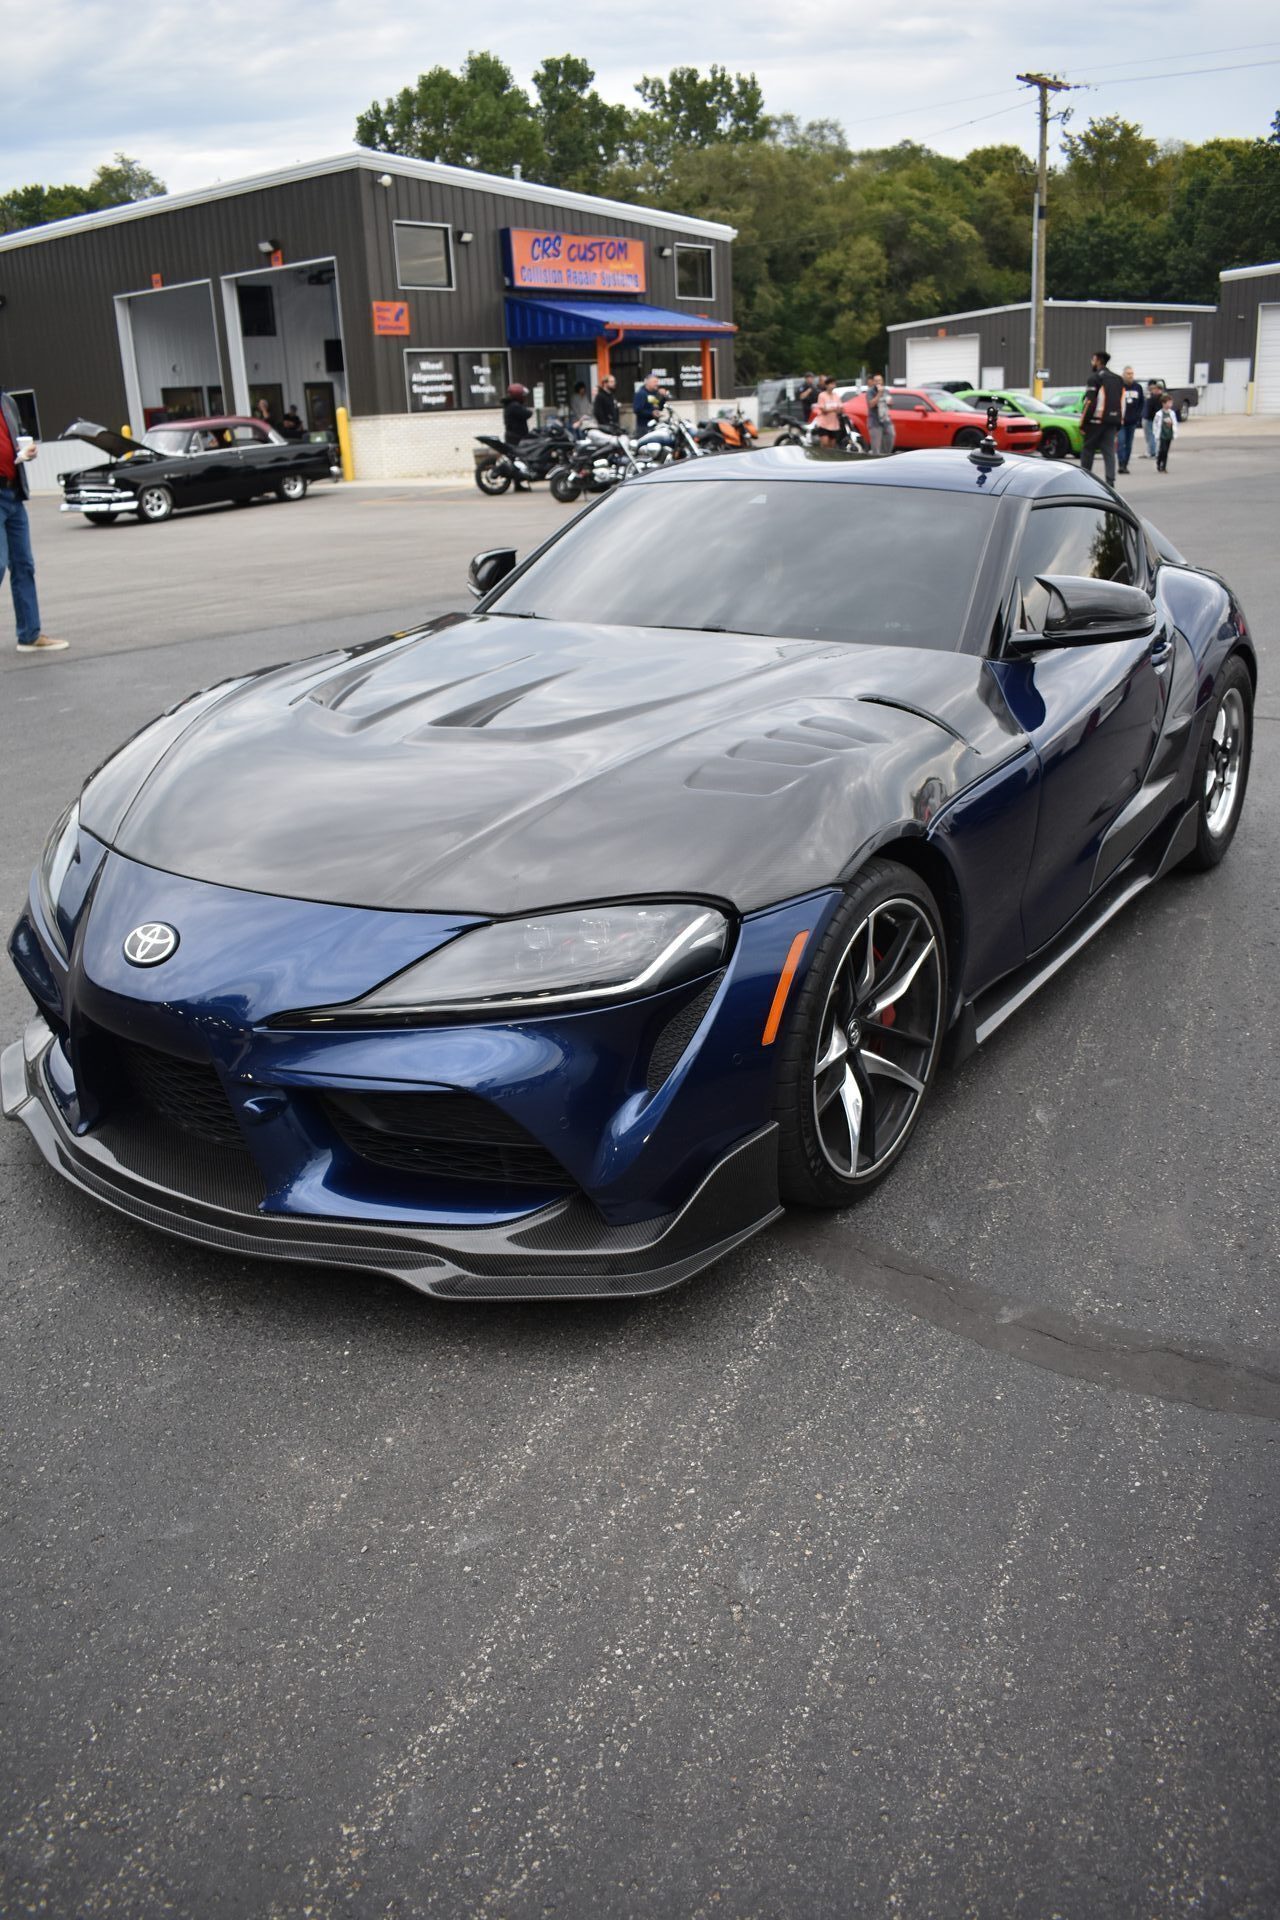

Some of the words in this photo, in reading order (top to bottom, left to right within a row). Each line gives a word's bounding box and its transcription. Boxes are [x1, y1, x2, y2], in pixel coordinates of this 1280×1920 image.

[531, 235, 562, 261] CRS
[567, 241, 628, 263] CUSTOM
[520, 266, 563, 284] Collision
[566, 269, 597, 286] Repair
[601, 272, 639, 288] Systems
[419, 361, 444, 371] Wheel
[411, 373, 454, 384] Alignments
[411, 383, 455, 394] Suspension
[470, 384, 496, 394] Wheels
[421, 395, 447, 405] Repair
